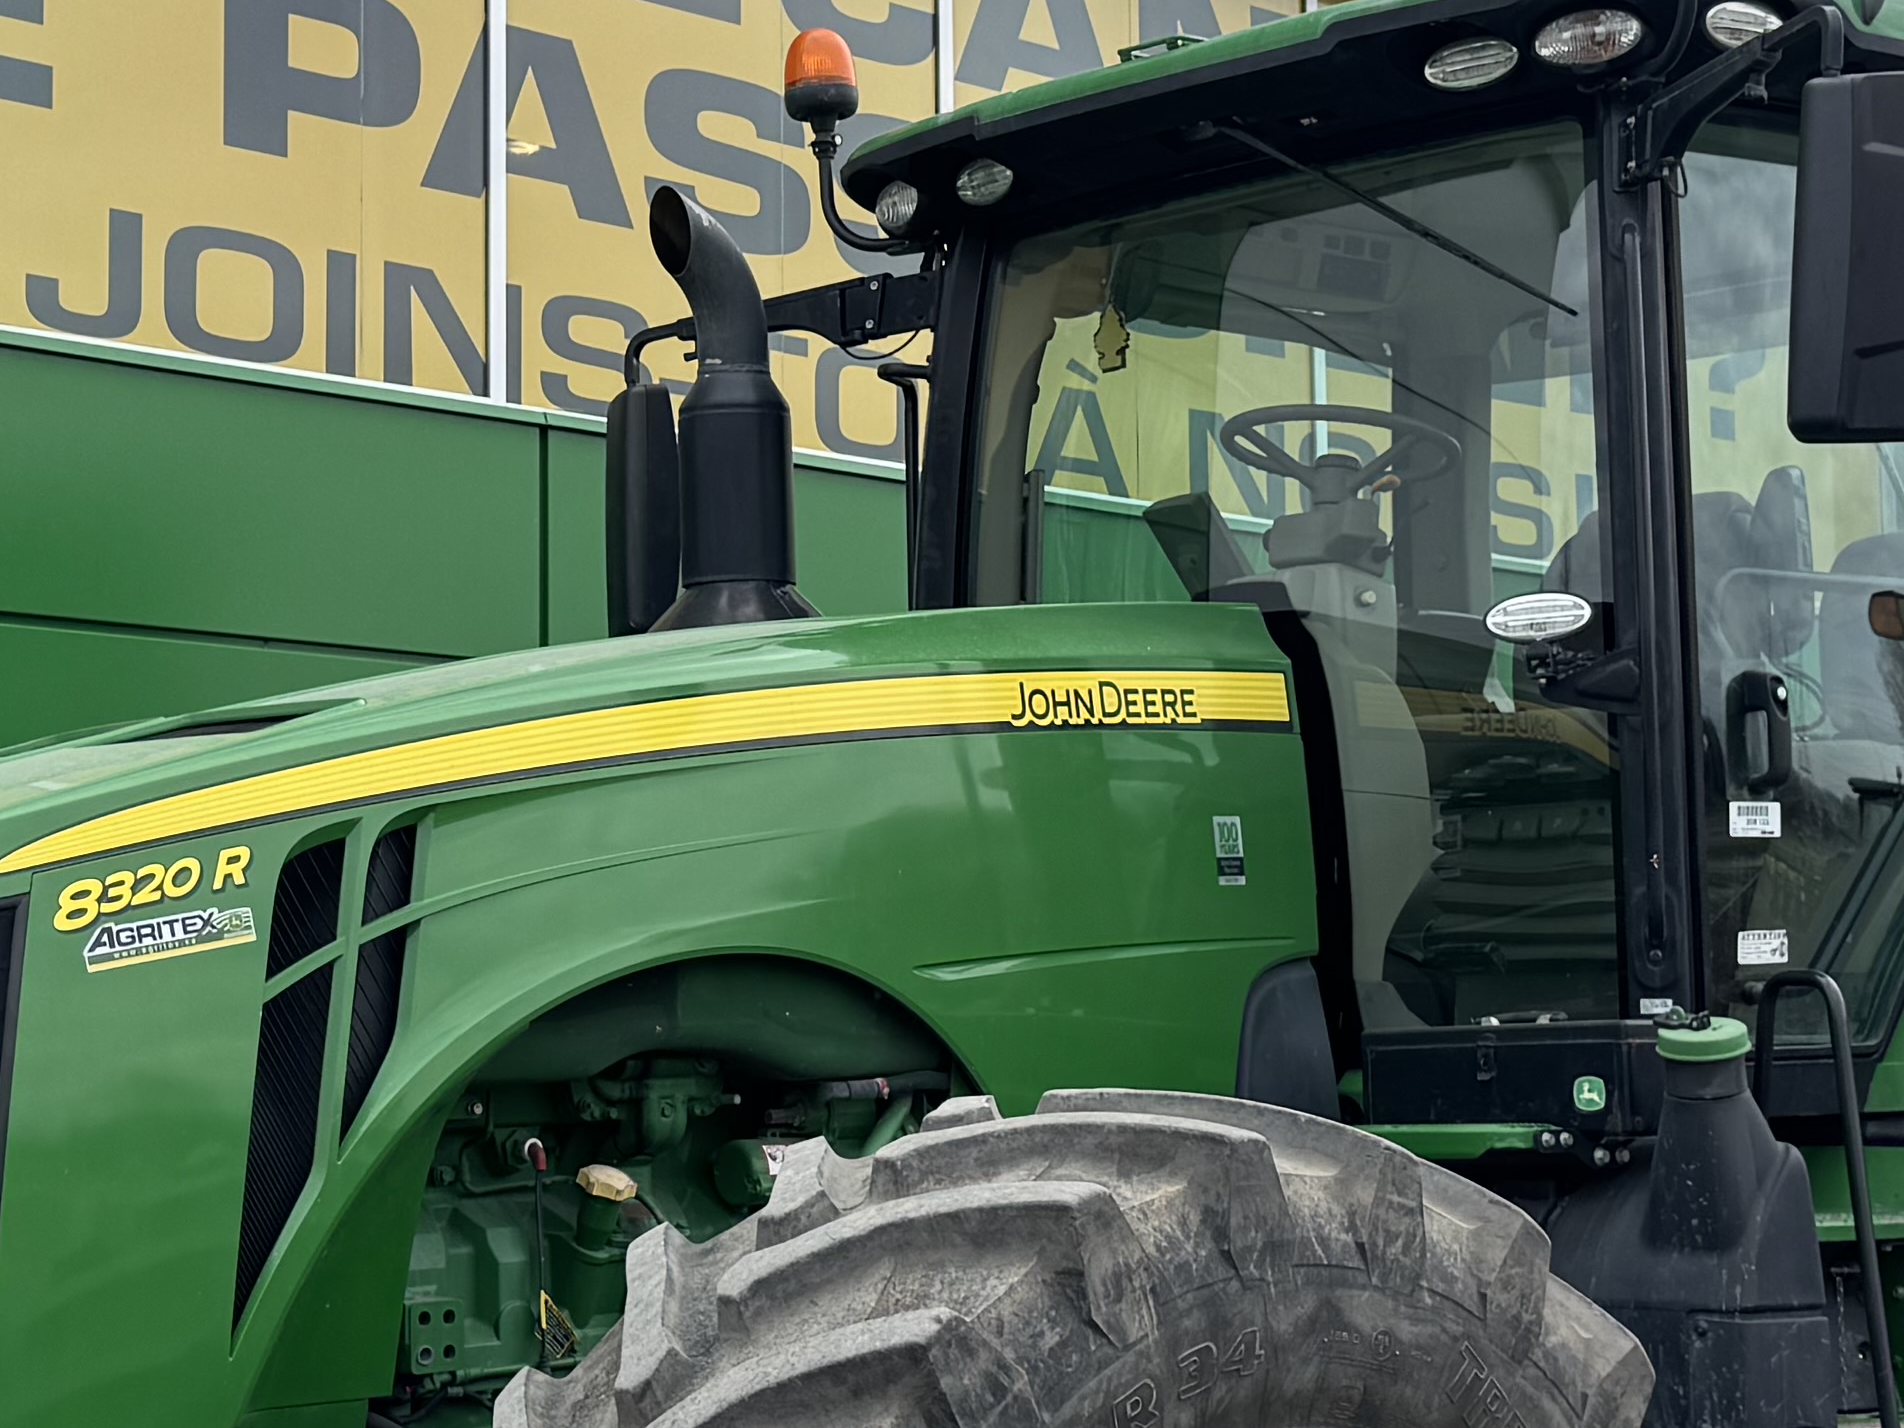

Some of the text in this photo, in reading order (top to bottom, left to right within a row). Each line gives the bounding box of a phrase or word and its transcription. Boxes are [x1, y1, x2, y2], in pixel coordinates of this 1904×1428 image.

[1010, 680, 1198, 722] JOHN DEERE
[53, 845, 252, 933] 8320 R
[87, 910, 220, 954] AGRITEX
[1176, 1325, 1268, 1402] 34
